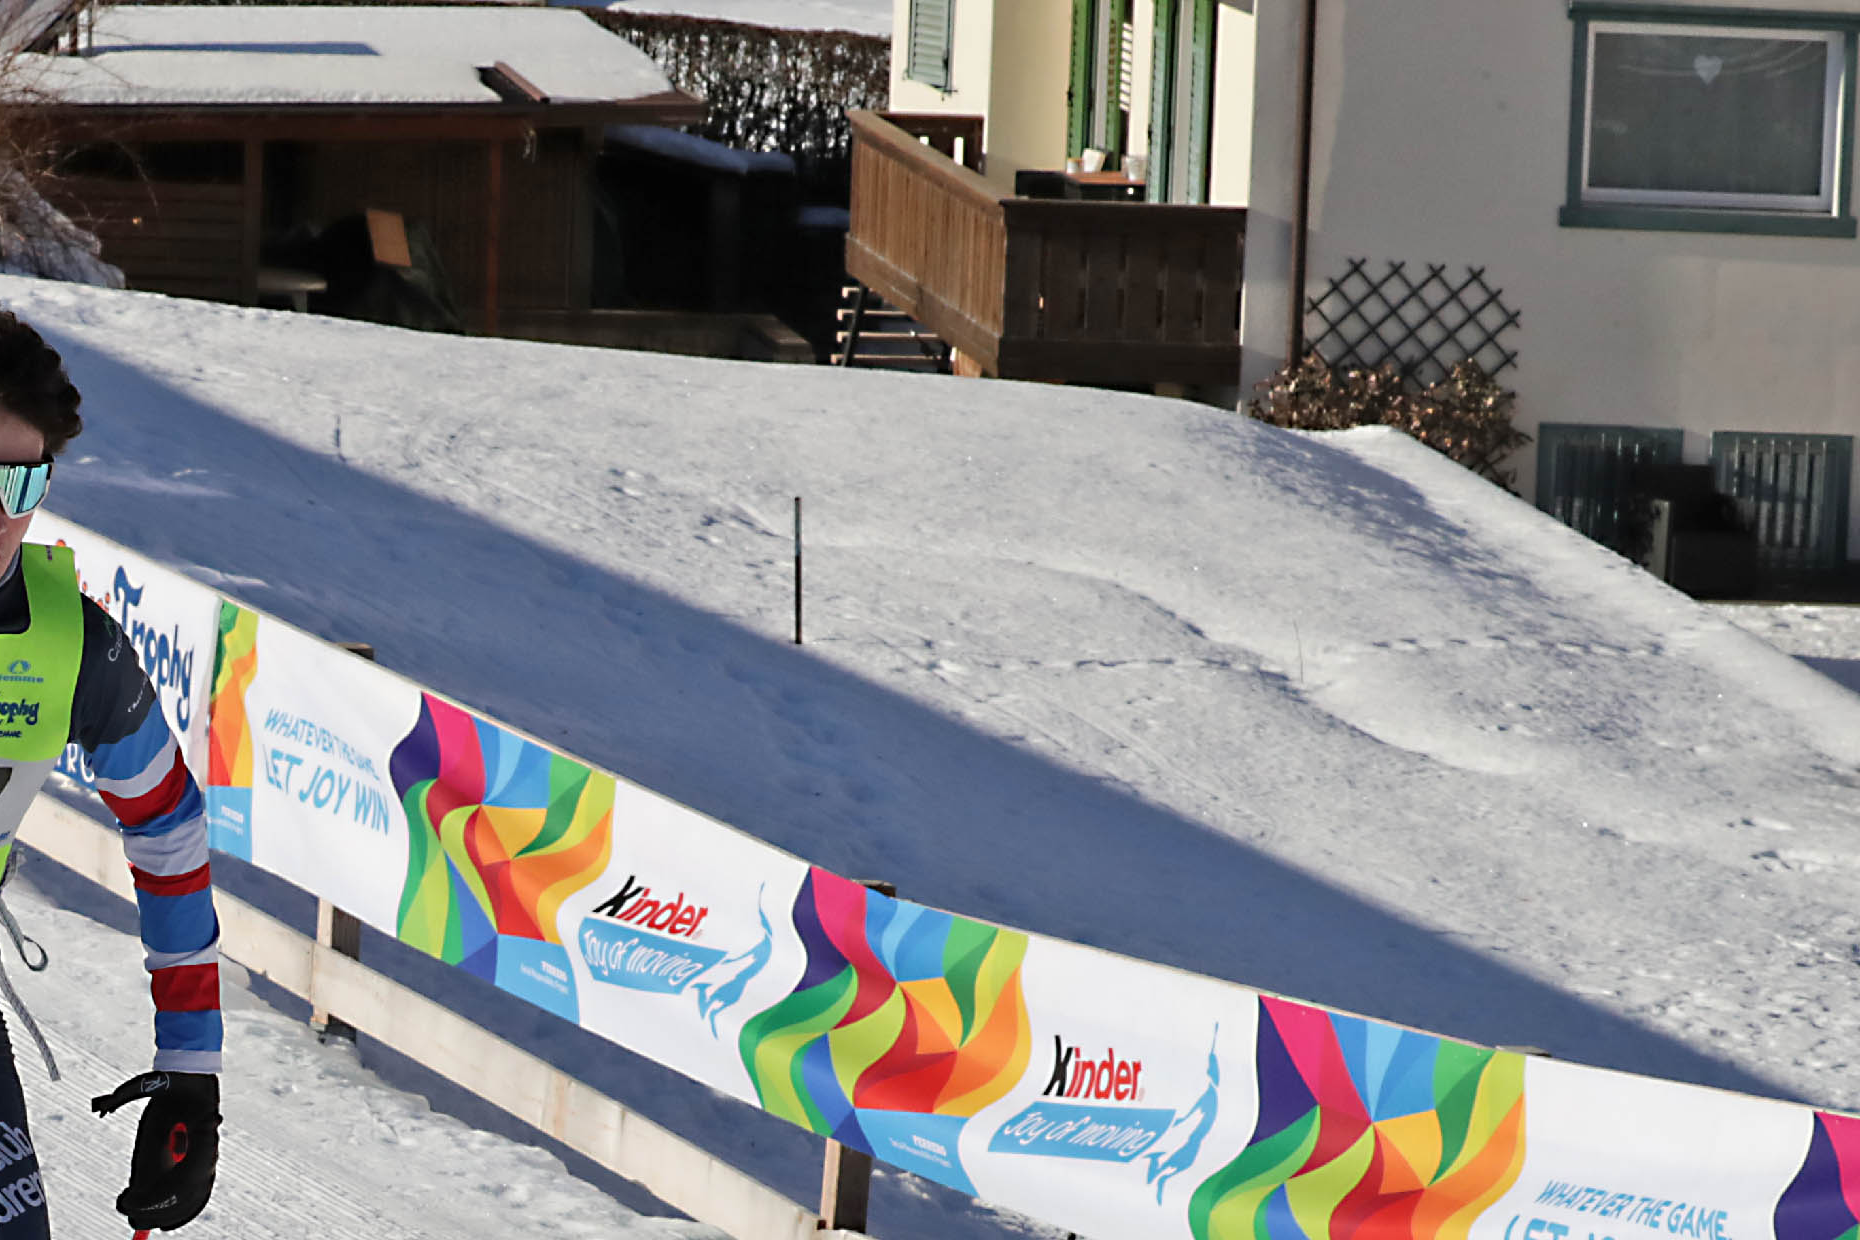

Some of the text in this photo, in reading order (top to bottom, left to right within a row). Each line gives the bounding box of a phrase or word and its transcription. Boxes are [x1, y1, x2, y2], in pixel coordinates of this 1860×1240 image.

[113, 565, 195, 733] Trophy
[299, 765, 351, 815] JOY
[354, 779, 389, 837] WIN
[626, 944, 704, 987] moving
[1067, 1119, 1157, 1157] moving
[1534, 1179, 1641, 1219] WHATEVER
[1626, 1196, 1673, 1229] THE
